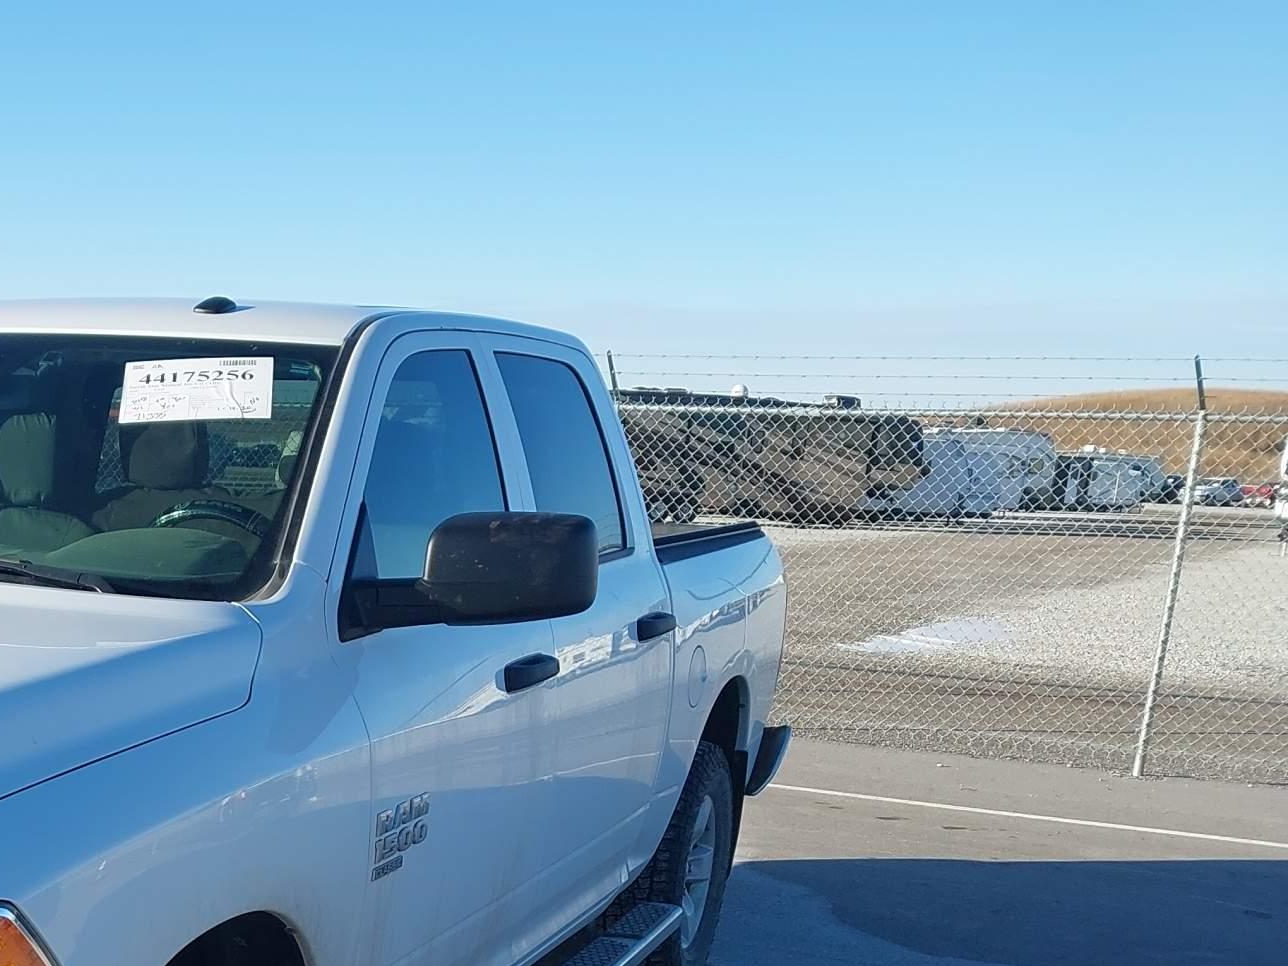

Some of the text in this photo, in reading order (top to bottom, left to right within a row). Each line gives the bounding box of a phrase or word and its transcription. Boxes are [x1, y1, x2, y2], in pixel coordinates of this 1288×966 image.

[138, 369, 255, 385] 44175256
[375, 792, 431, 837] RAM
[374, 819, 429, 864] 1500
